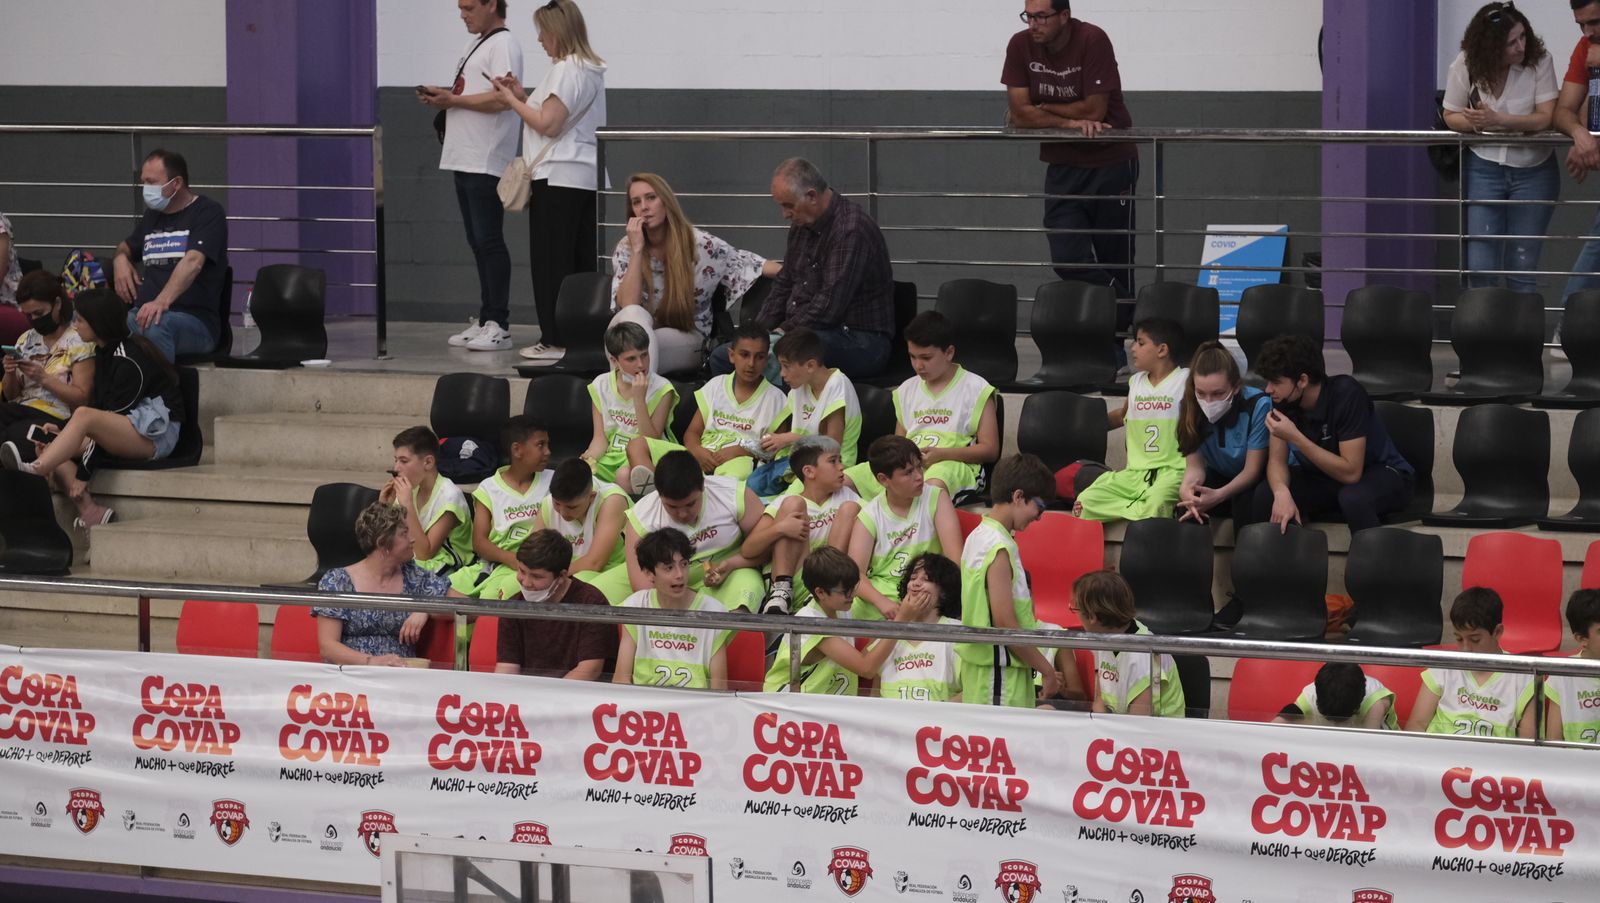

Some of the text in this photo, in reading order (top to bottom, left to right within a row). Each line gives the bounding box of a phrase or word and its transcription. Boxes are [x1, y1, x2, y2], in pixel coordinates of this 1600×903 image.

[1137, 402, 1172, 411] COVAP
[1144, 425, 1159, 452] 2
[508, 509, 538, 520] COVA
[689, 530, 717, 545] OVAP
[649, 631, 697, 643] Muévete
[655, 640, 695, 651] COVAP
[899, 660, 933, 671] COVAP
[655, 665, 692, 687] 22
[0, 665, 82, 709] COPA
[140, 675, 226, 720] COPA
[286, 684, 375, 729] COPA
[0, 704, 96, 745] COVAP
[436, 694, 529, 739] COPA
[132, 714, 241, 755] COVAP
[592, 703, 688, 749] COPA
[1454, 719, 1494, 737] 20
[278, 724, 390, 766] COVAP
[753, 712, 848, 761] COPA
[0, 747, 25, 760] UCHO
[427, 733, 542, 776] COVAP
[915, 726, 1016, 776] COPA
[135, 756, 166, 771] MUCHO
[583, 742, 702, 787] COVAP
[1086, 738, 1189, 789] COPA
[280, 767, 313, 782] MUCHO
[743, 753, 863, 800] COVAP
[1261, 752, 1370, 802] COPA
[430, 777, 465, 792] MUCHO
[906, 767, 1029, 813] COVAP
[1441, 767, 1557, 816] COPA
[72, 799, 99, 808] COVAP
[585, 788, 622, 804] MUCHO
[1072, 781, 1206, 828] COVAP
[215, 811, 244, 821] COVAP
[744, 800, 781, 816] MUCHO
[363, 822, 393, 832] COVAP
[908, 812, 946, 829] MUCHO
[1250, 794, 1387, 843] COVAP
[516, 833, 546, 844] COVAP
[1078, 826, 1116, 842] MUCHO
[1434, 808, 1575, 857] COVAP
[673, 845, 704, 856] COVAP
[1250, 842, 1289, 858] MUCHO
[834, 859, 866, 870] COVAP
[1432, 856, 1474, 873] MUCHO
[1002, 873, 1035, 883] COVAP
[1175, 887, 1209, 898] COVAP
